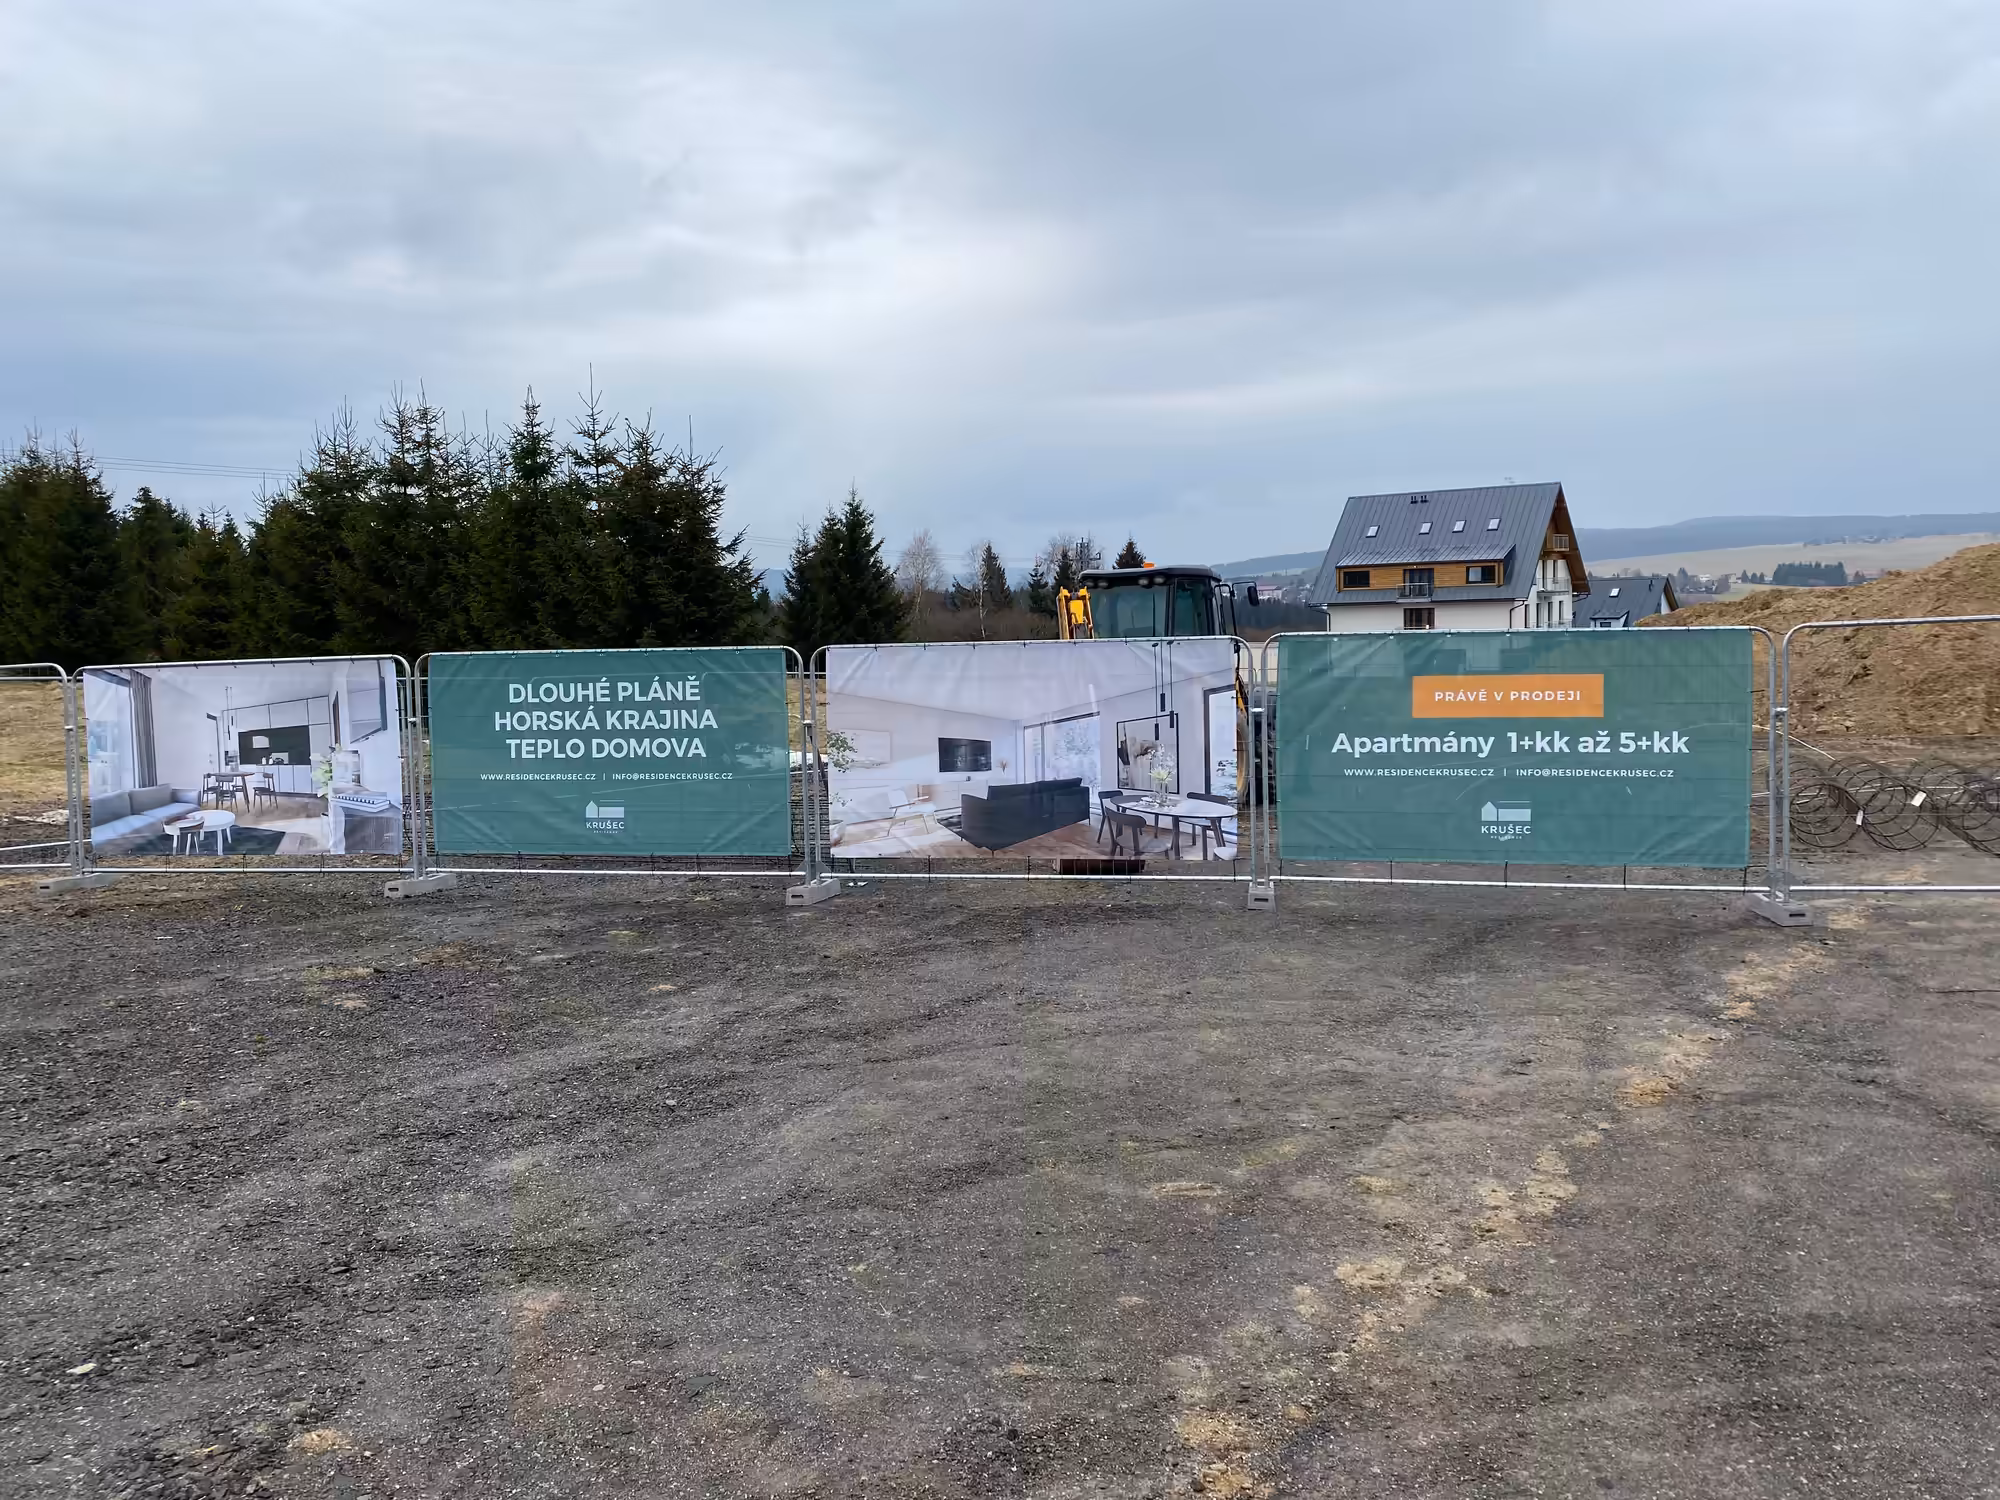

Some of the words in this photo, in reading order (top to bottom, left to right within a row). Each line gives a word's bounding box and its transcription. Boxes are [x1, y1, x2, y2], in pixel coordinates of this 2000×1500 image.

[508, 676, 611, 703] DLOUHÉ
[617, 675, 700, 702] PLÁNĚ
[1434, 689, 1488, 702] PRÁVĚ
[1494, 691, 1503, 701] V
[1510, 690, 1581, 702] PRODEJI
[494, 705, 600, 731] HORSKÁ
[606, 708, 719, 730] KRAJINA
[505, 738, 585, 759] TEPLO
[591, 737, 707, 759] DOMOVA
[1331, 731, 1495, 759] Apartmány
[1507, 731, 1571, 753] 1+kk
[1577, 730, 1611, 753] až
[1618, 731, 1690, 754] 5+kk
[480, 773, 596, 781] WWW.RESIDENCEKRUSEC.CZ
[612, 772, 733, 780] INFO@RESIDENCEKRUSEC.CZ
[1344, 768, 1495, 777] WWW.RESIDENCEKRUSEC.CZ
[1516, 768, 1674, 778] INFO@RESIDENCEKRUSEC.CZ
[585, 820, 625, 829] KRUŠEC
[1481, 824, 1532, 834] KRUŠEC
